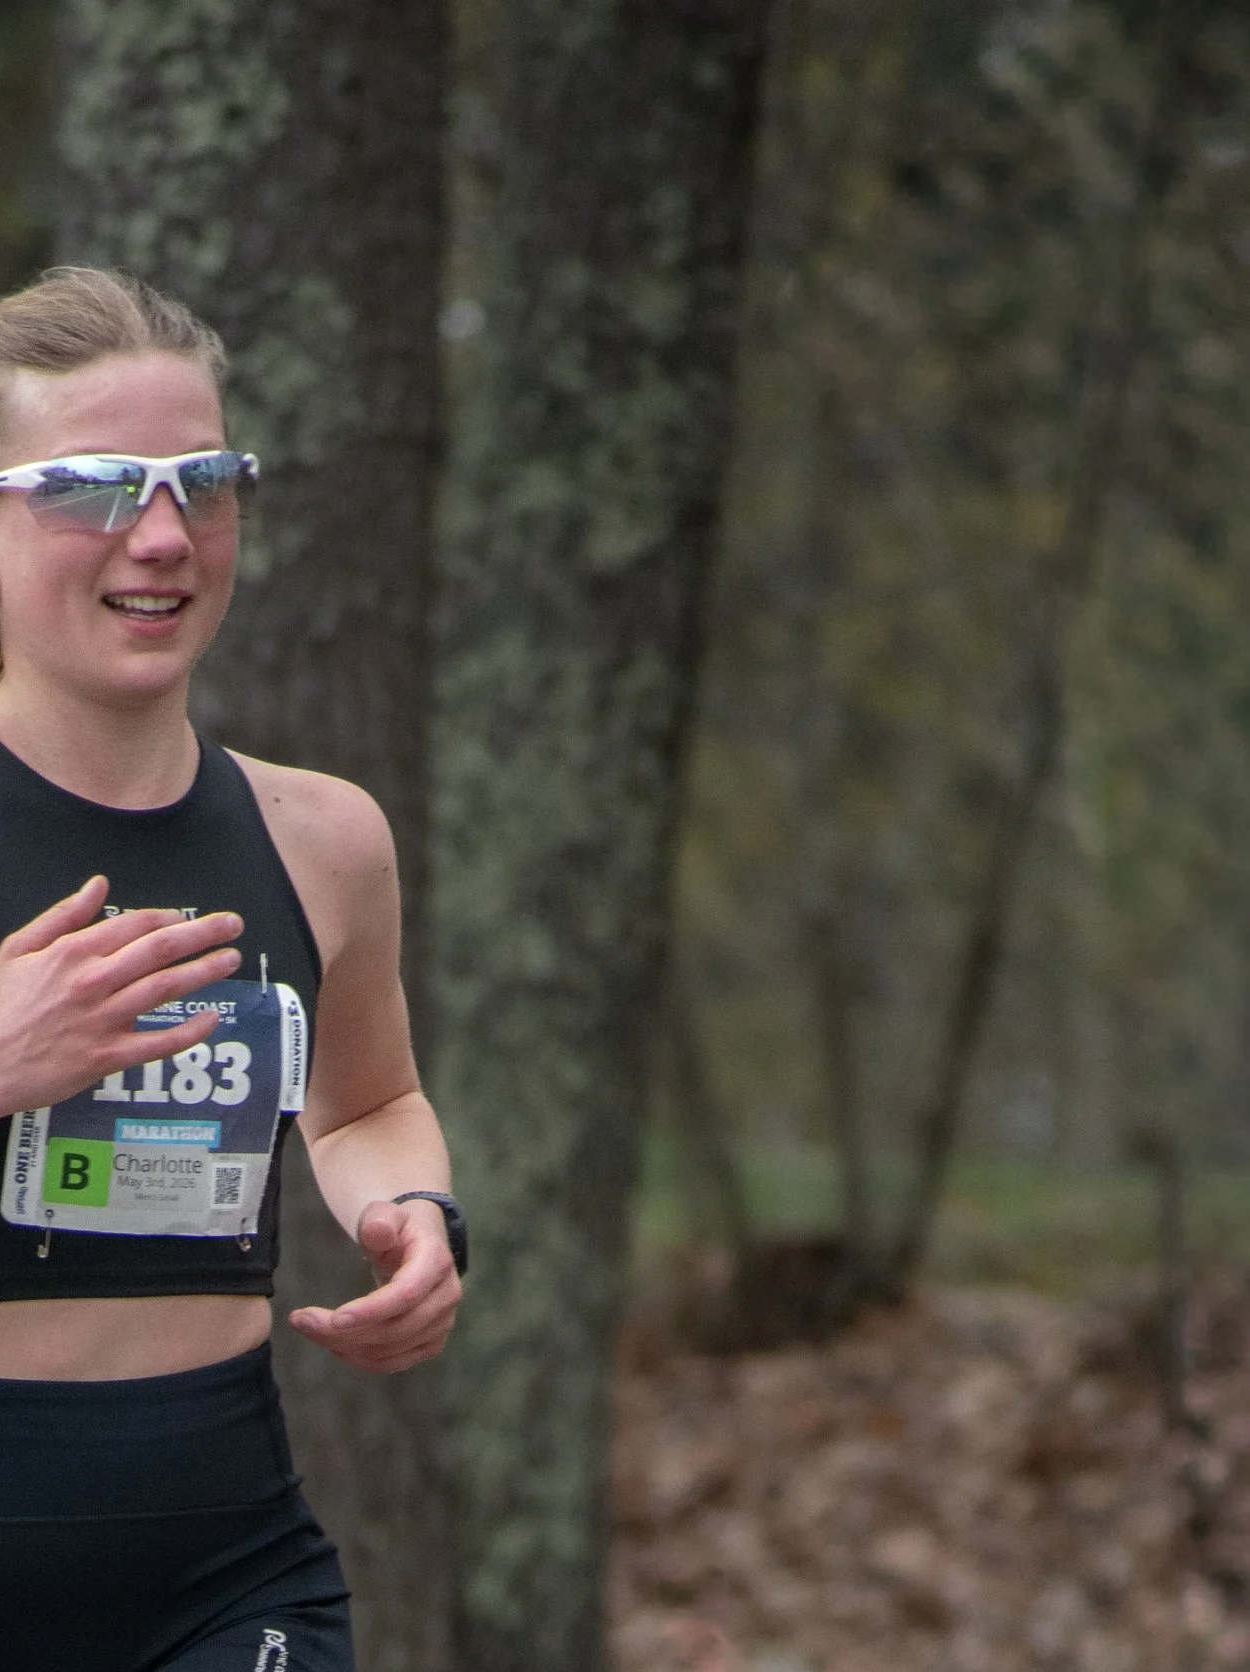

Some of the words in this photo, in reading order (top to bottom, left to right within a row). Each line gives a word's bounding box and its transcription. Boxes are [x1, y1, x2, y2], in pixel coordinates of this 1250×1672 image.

[186, 1001, 237, 1014] COAST
[293, 1019, 302, 1087] DONATION
[19, 1111, 36, 1148] BEER
[121, 1124, 217, 1140] MARATHON
[15, 1151, 31, 1184] ONE
[60, 1152, 91, 1191] B
[113, 1153, 204, 1174] Charlotte
[117, 1176, 143, 1190] May
